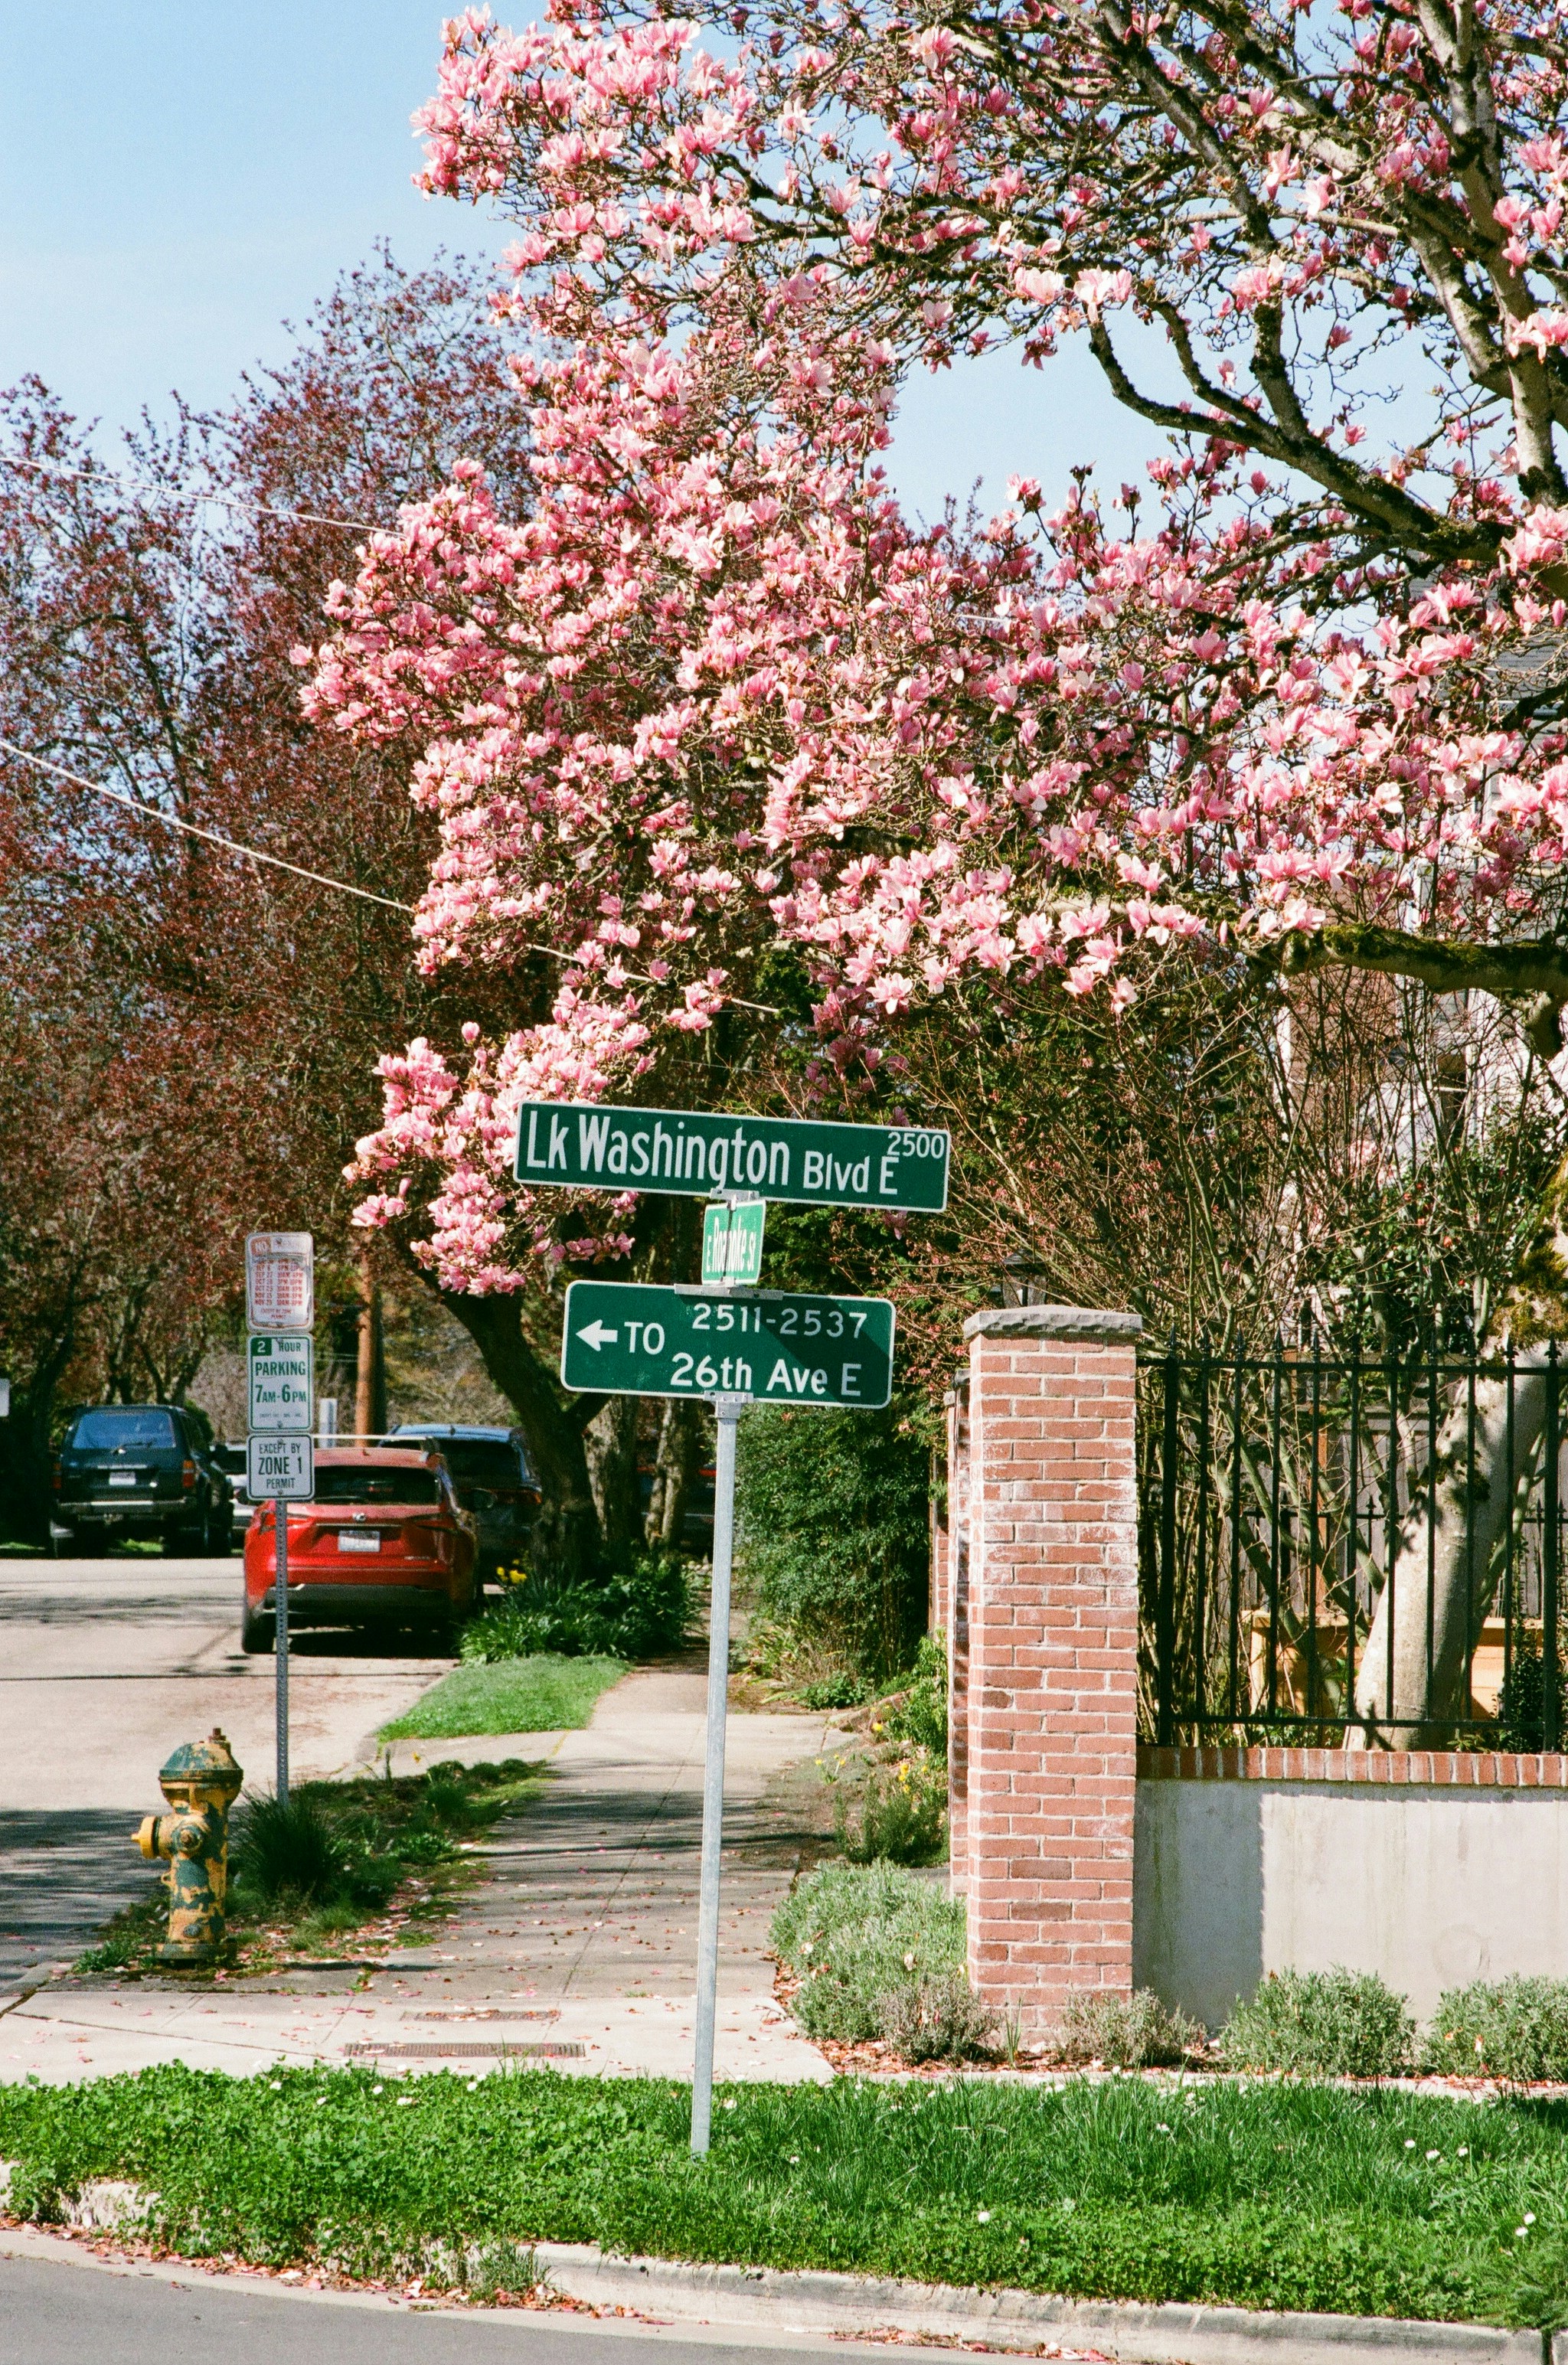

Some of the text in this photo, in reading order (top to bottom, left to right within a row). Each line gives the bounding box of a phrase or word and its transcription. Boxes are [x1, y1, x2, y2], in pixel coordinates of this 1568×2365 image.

[527, 1109, 900, 1195] Lk Washington Blvd E
[887, 1132, 945, 1160] 2500
[693, 1303, 867, 1339] 2511-2537
[257, 1341, 301, 1353] 2 HOUR
[624, 1321, 665, 1354] TO
[255, 1361, 306, 1376] PARKING
[671, 1352, 862, 1396] 26th Ave E
[259, 1442, 302, 1454] EXCEPT BY
[258, 1456, 302, 1475] ZONE 1
[266, 1478, 296, 1489] PERMIT
